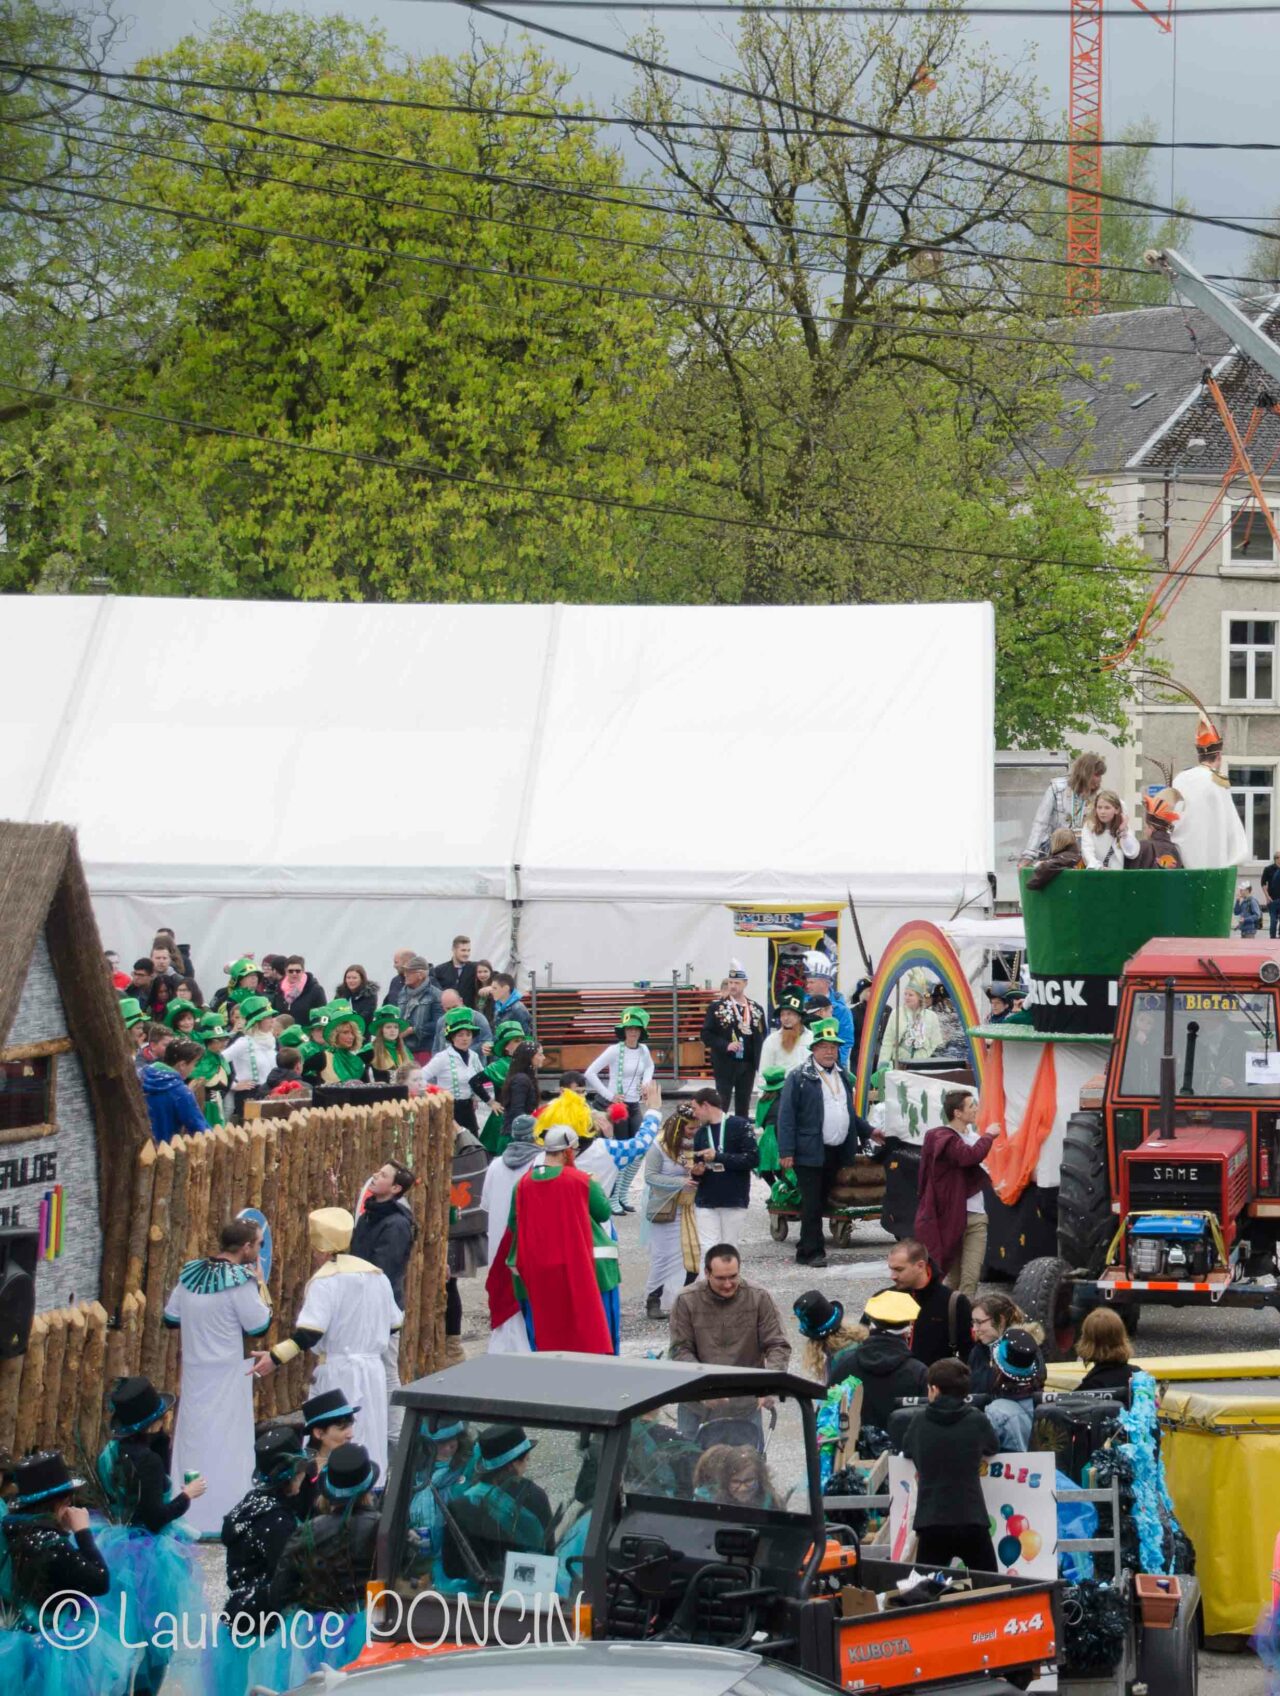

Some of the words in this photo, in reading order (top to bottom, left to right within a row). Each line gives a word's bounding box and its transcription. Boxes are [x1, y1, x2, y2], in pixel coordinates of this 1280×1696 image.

[1153, 1167, 1198, 1180] SAME
[971, 1629, 998, 1644] Diesel
[1003, 1613, 1044, 1635] 4x4
[848, 1638, 913, 1664] KUBOTA
